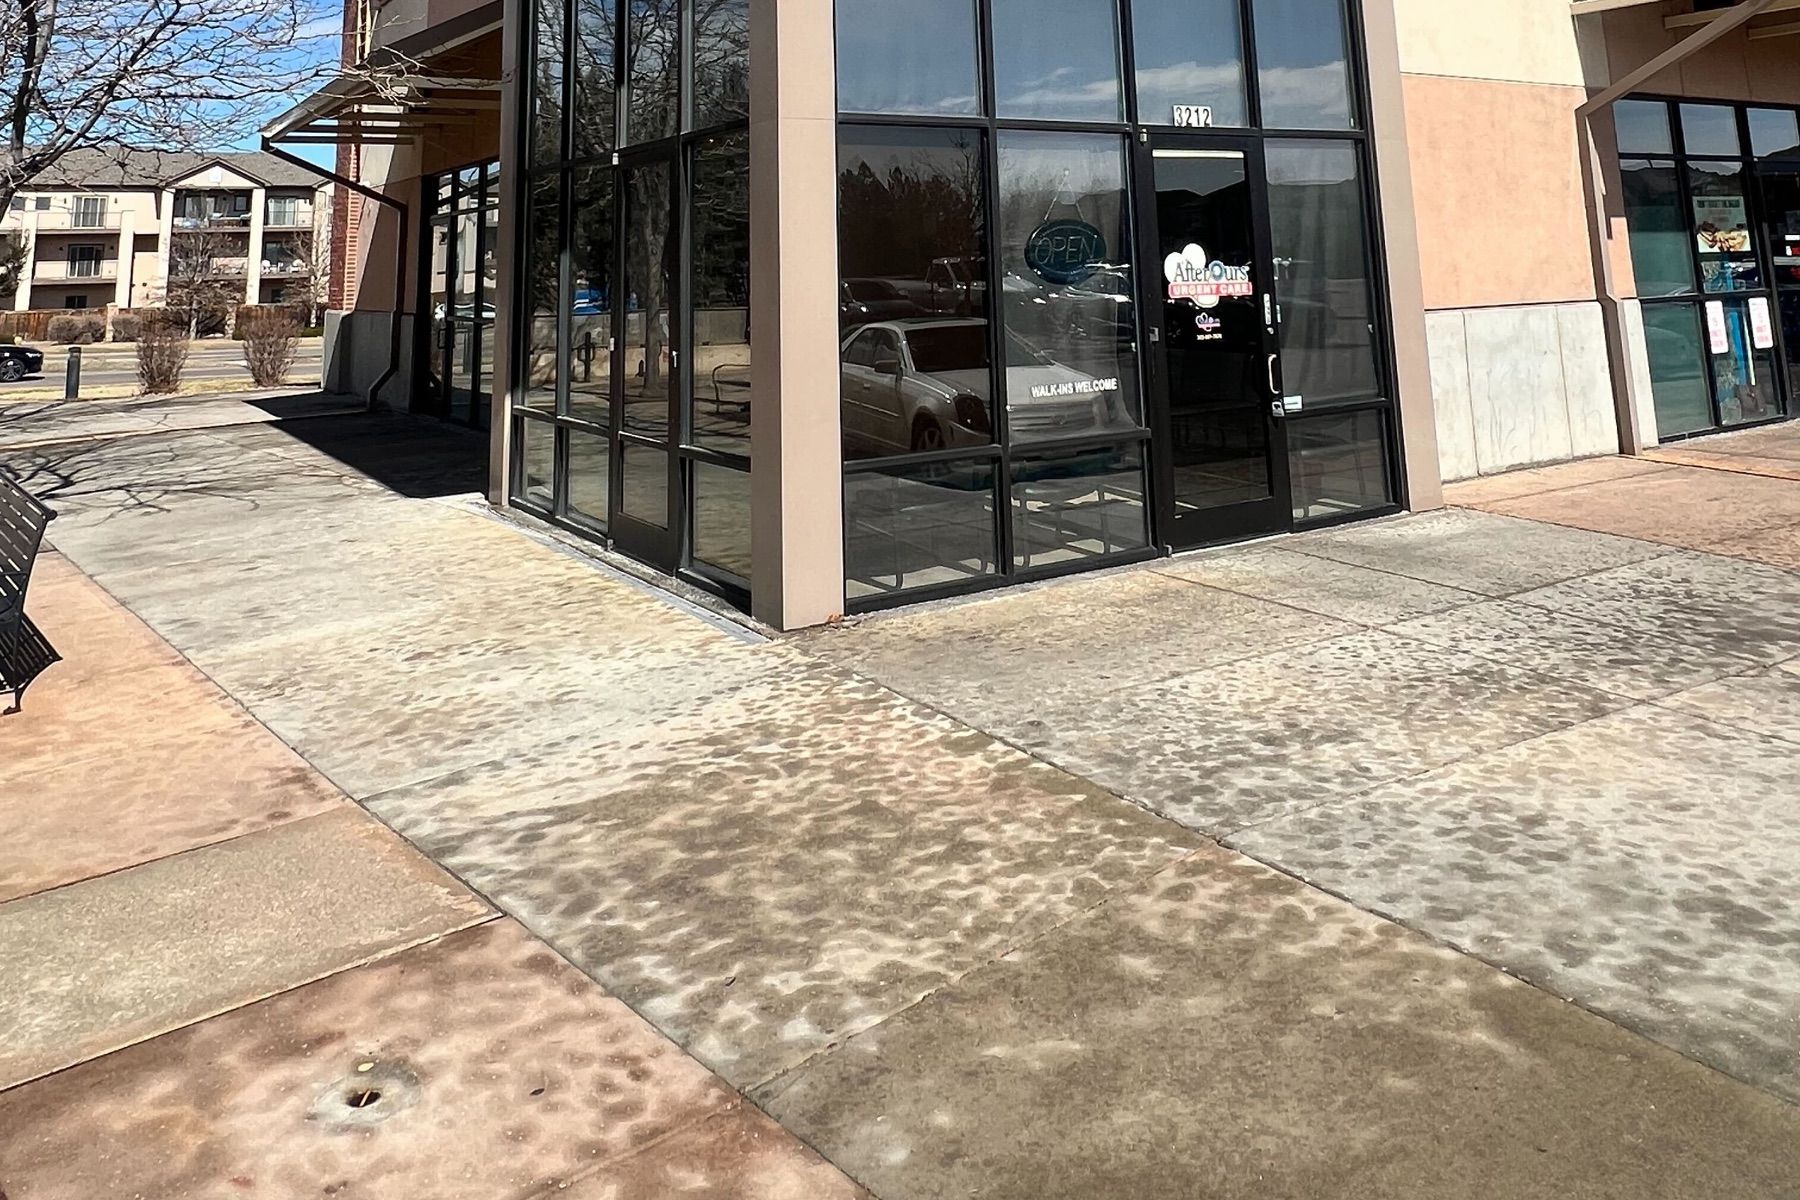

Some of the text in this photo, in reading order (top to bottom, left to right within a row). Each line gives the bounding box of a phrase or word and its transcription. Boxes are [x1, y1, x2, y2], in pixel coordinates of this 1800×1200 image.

[1175, 106, 1211, 127] 3212
[1034, 235, 1096, 264] OPEN
[1172, 283, 1249, 296] URGENT CARE
[1031, 377, 1118, 398] WALK-INS WELCOME
